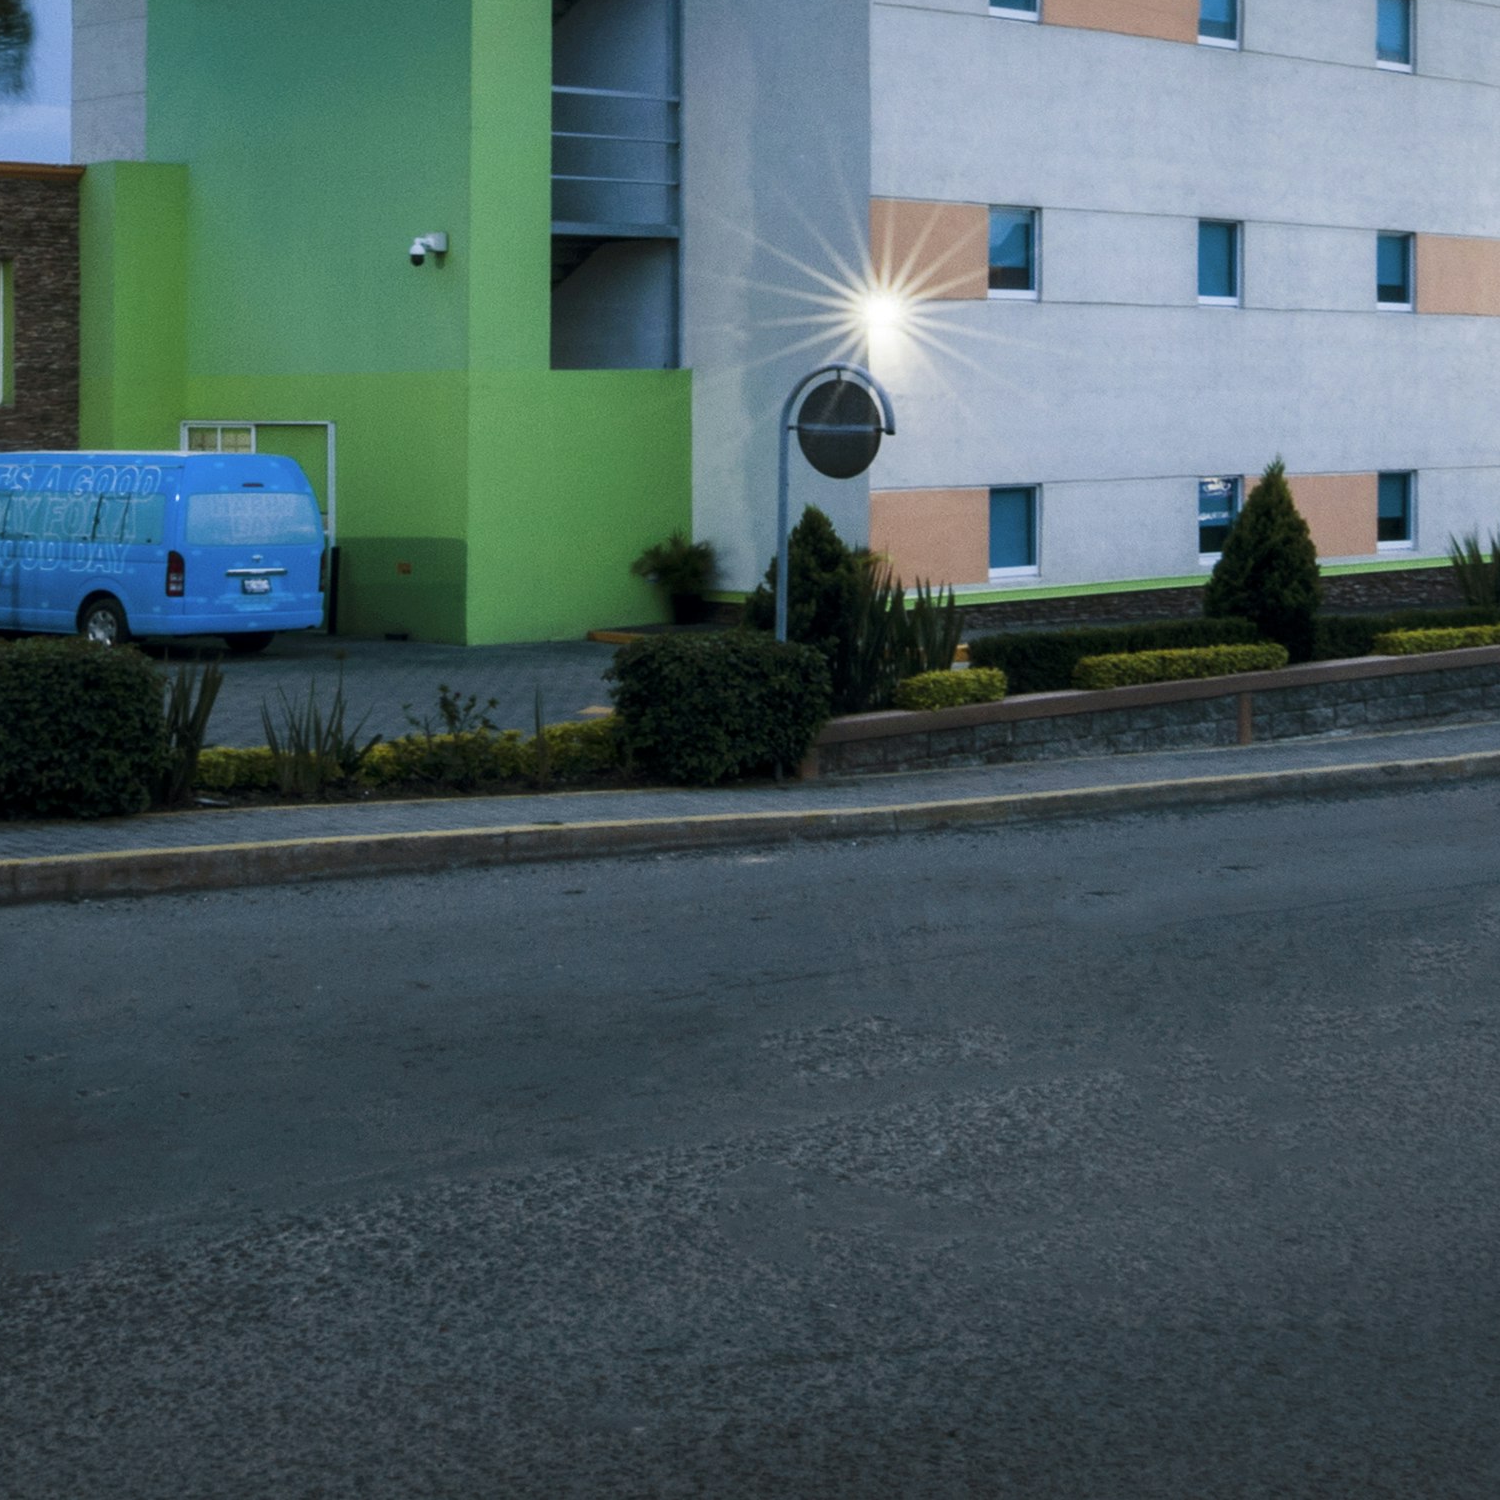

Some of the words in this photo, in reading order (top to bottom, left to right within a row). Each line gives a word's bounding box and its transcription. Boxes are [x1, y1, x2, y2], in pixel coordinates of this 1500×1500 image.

[34, 464, 62, 500] A
[68, 465, 162, 503] GOOD
[43, 496, 108, 538] FOR
[68, 537, 135, 575] DAY
